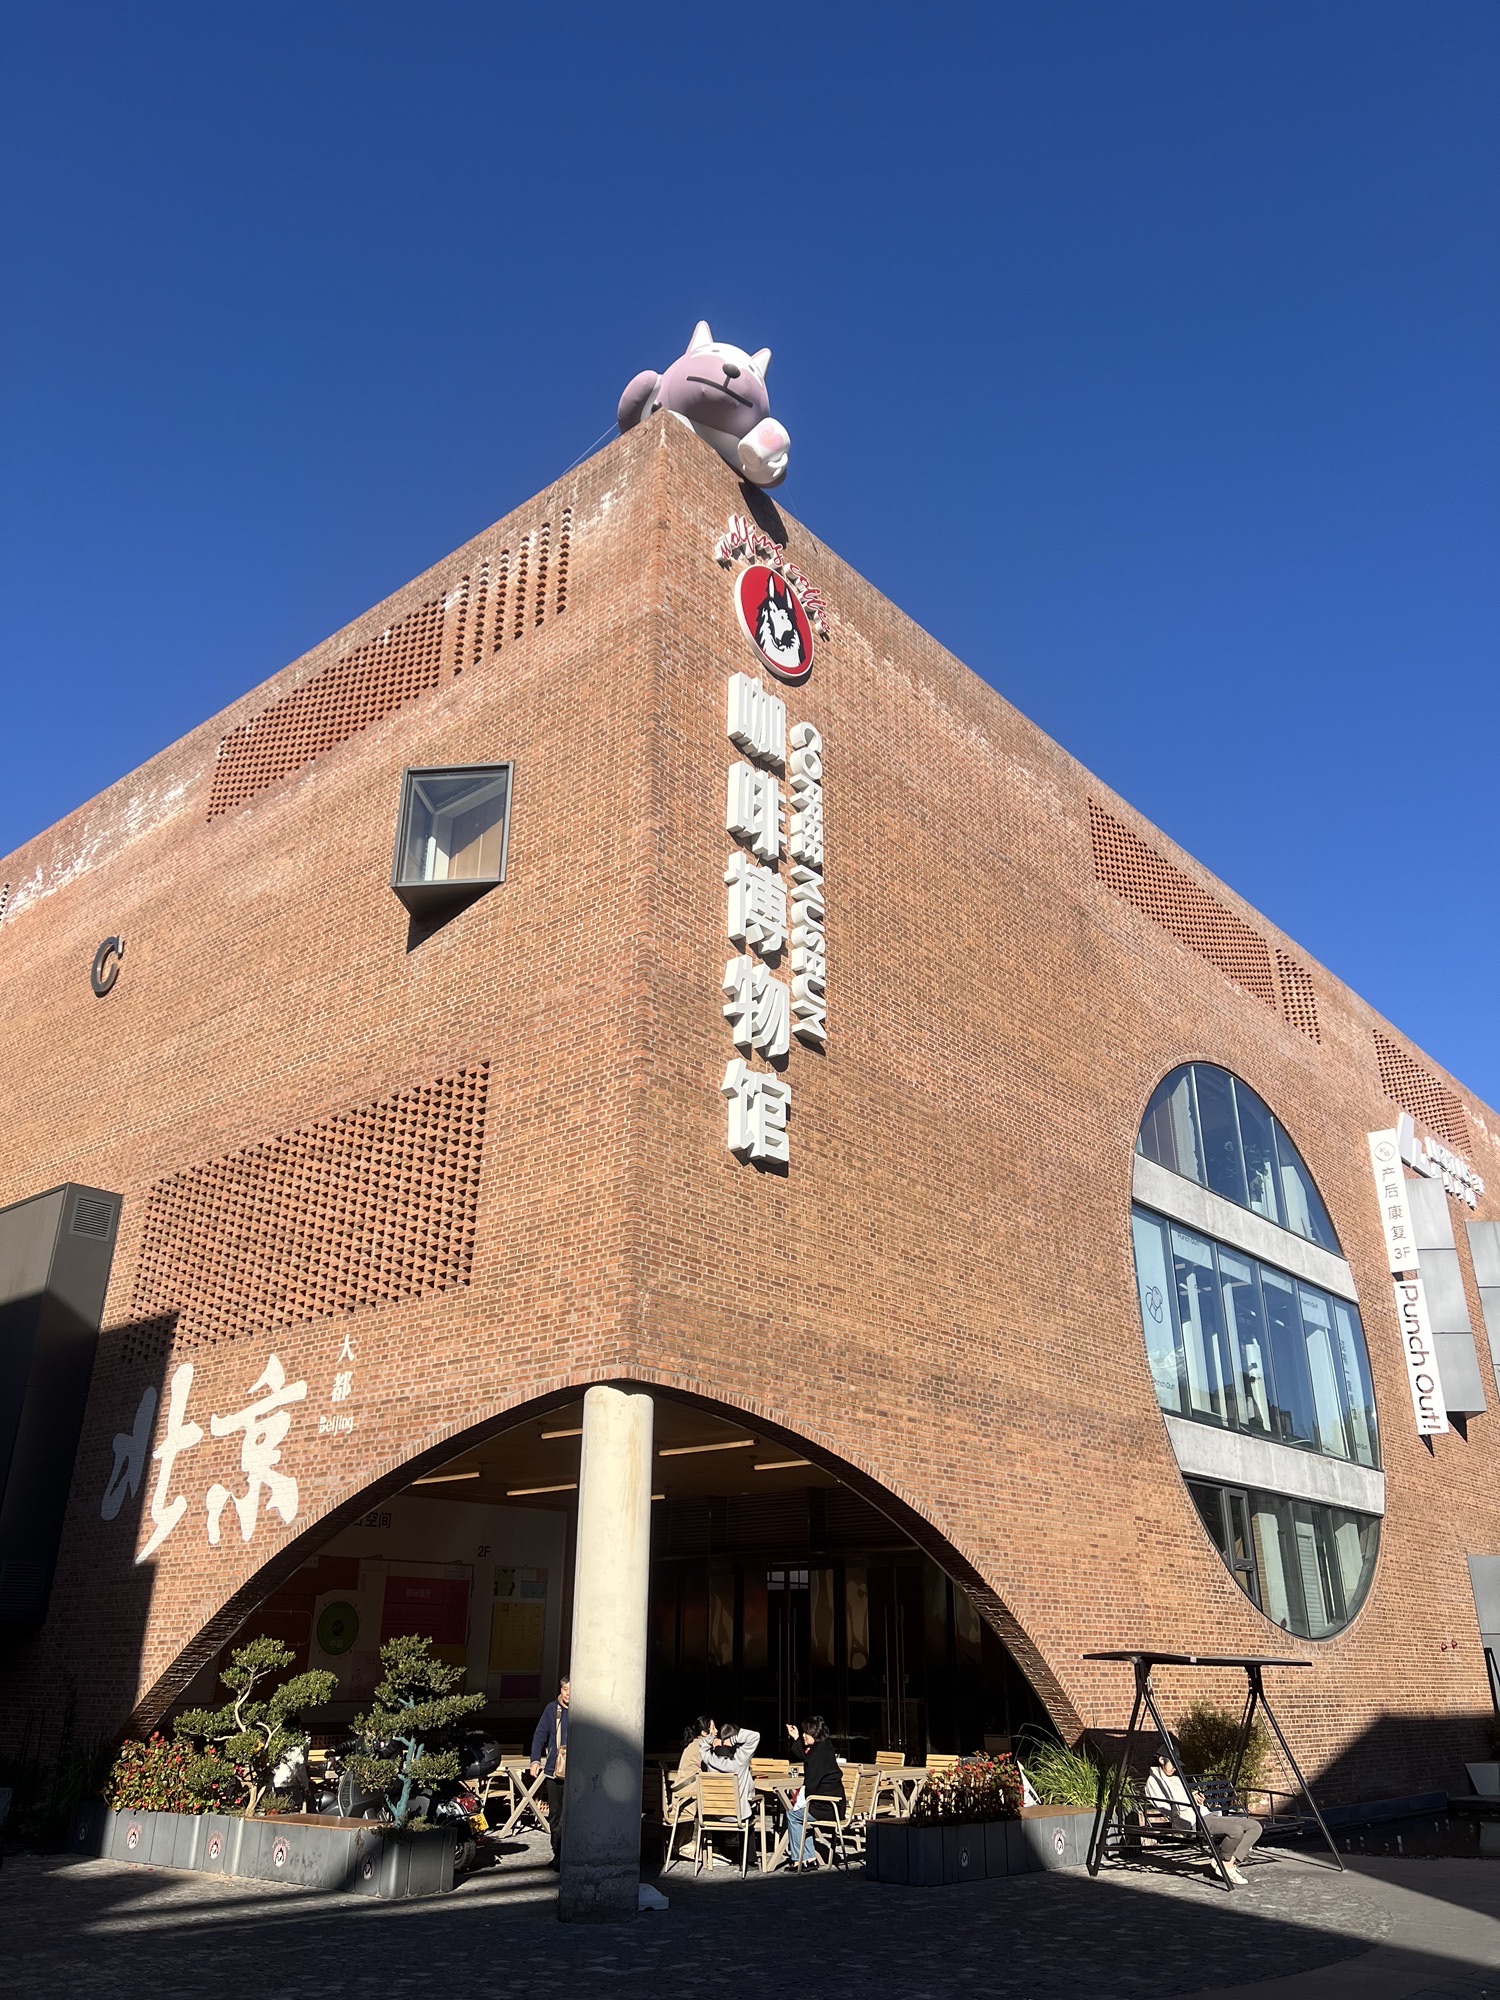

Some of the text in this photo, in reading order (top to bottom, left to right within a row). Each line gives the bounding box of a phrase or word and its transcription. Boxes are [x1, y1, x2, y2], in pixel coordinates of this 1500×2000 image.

[724, 671, 791, 1165] 咖啡博物馆
[789, 722, 827, 1044] COFFEE MUSEUM
[1382, 1166, 1407, 1241] 产后康复
[1394, 1246, 1411, 1260] 3F
[331, 1334, 356, 1402] 大都
[1399, 1284, 1441, 1430] Punch Out!
[100, 1353, 308, 1565] 北京
[318, 1416, 355, 1437] Beijing
[477, 1545, 491, 1558] 2F
